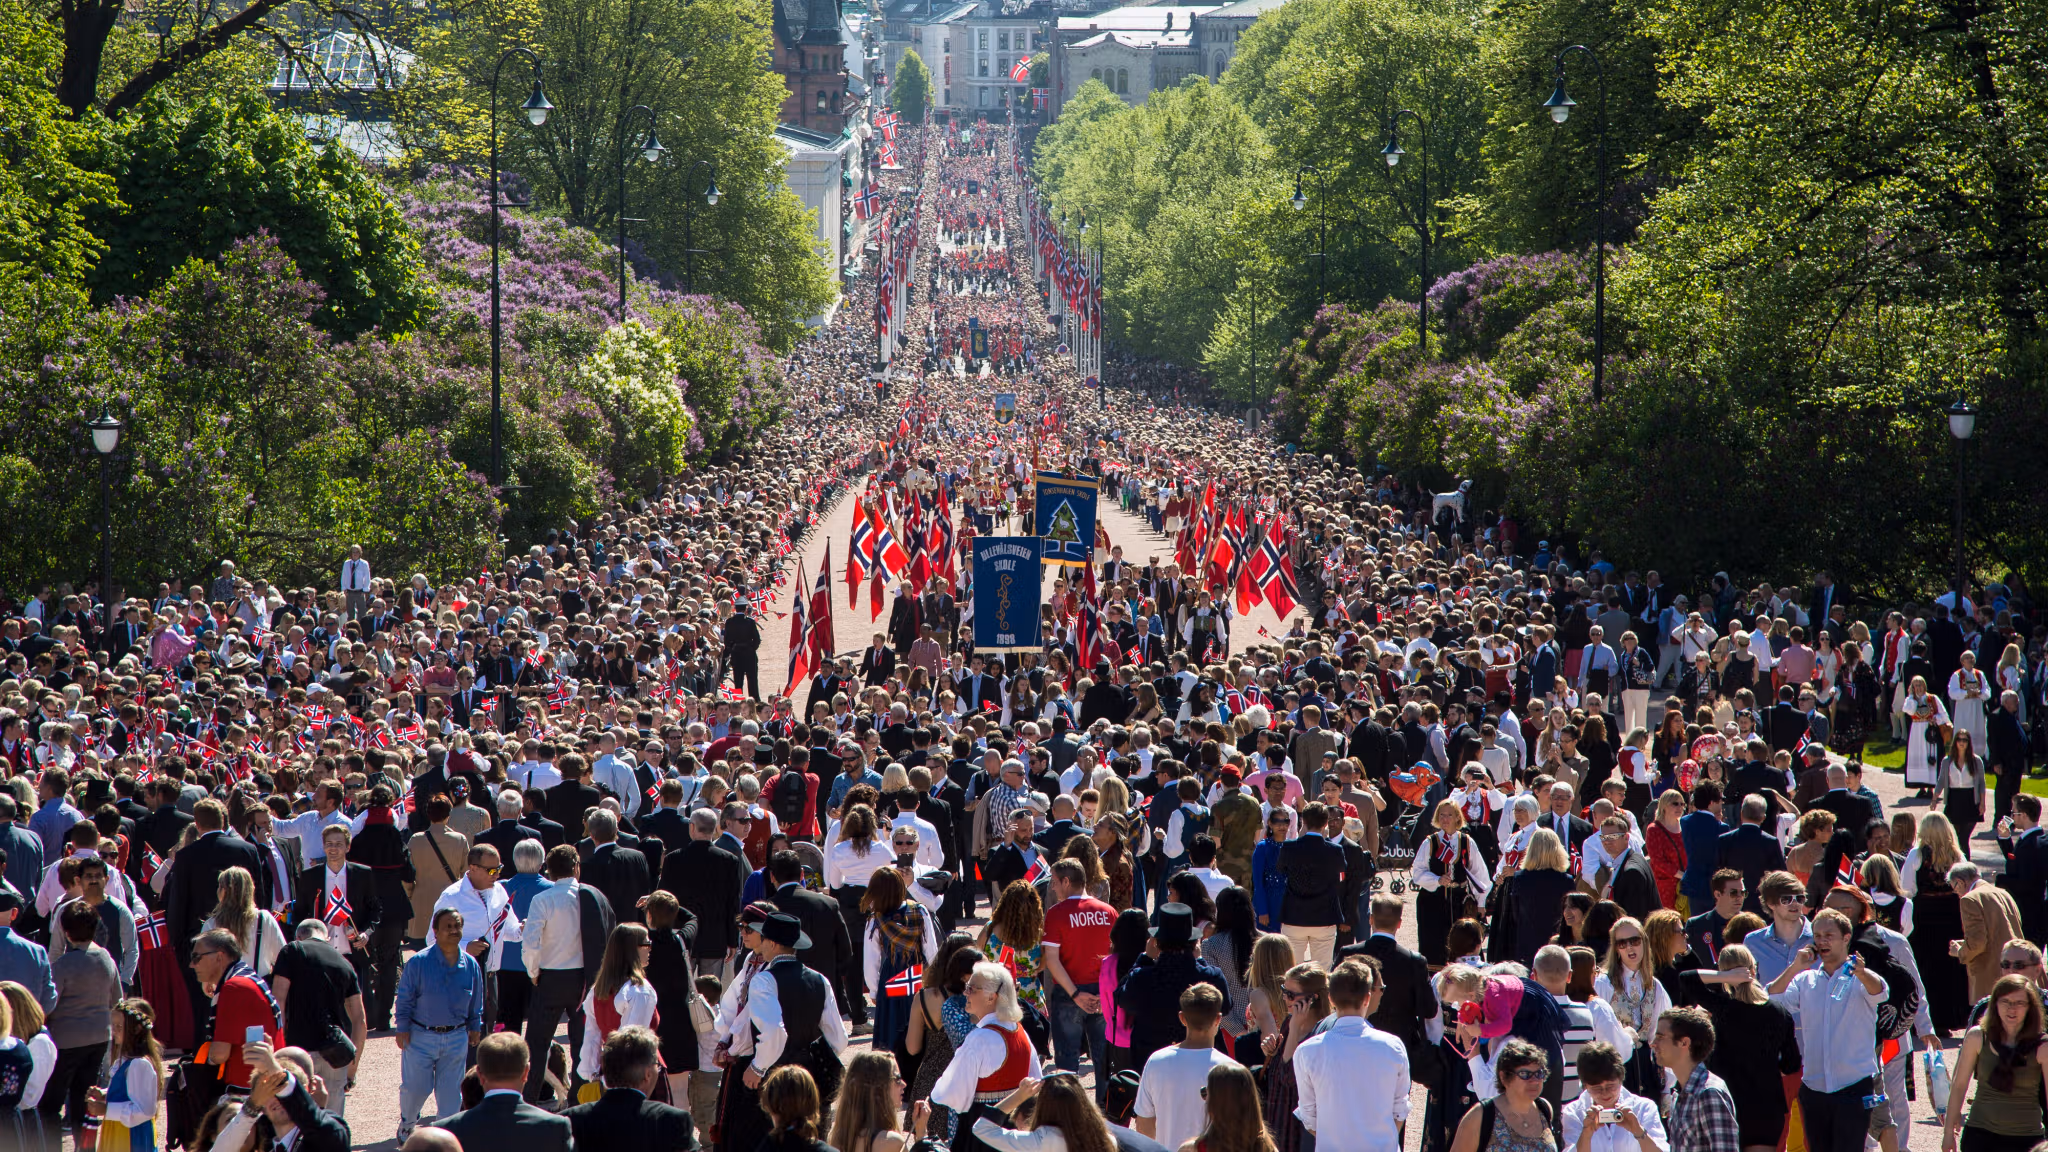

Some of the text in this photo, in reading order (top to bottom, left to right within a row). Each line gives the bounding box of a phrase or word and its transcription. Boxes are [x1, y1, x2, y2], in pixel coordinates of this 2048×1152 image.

[980, 542, 1032, 561] ULLEVÅLSVEIEN
[993, 559, 1017, 572] SKOLE
[996, 633, 1016, 645] 1898
[1381, 844, 1415, 858] Cubus
[1069, 911, 1111, 928] NORGE
